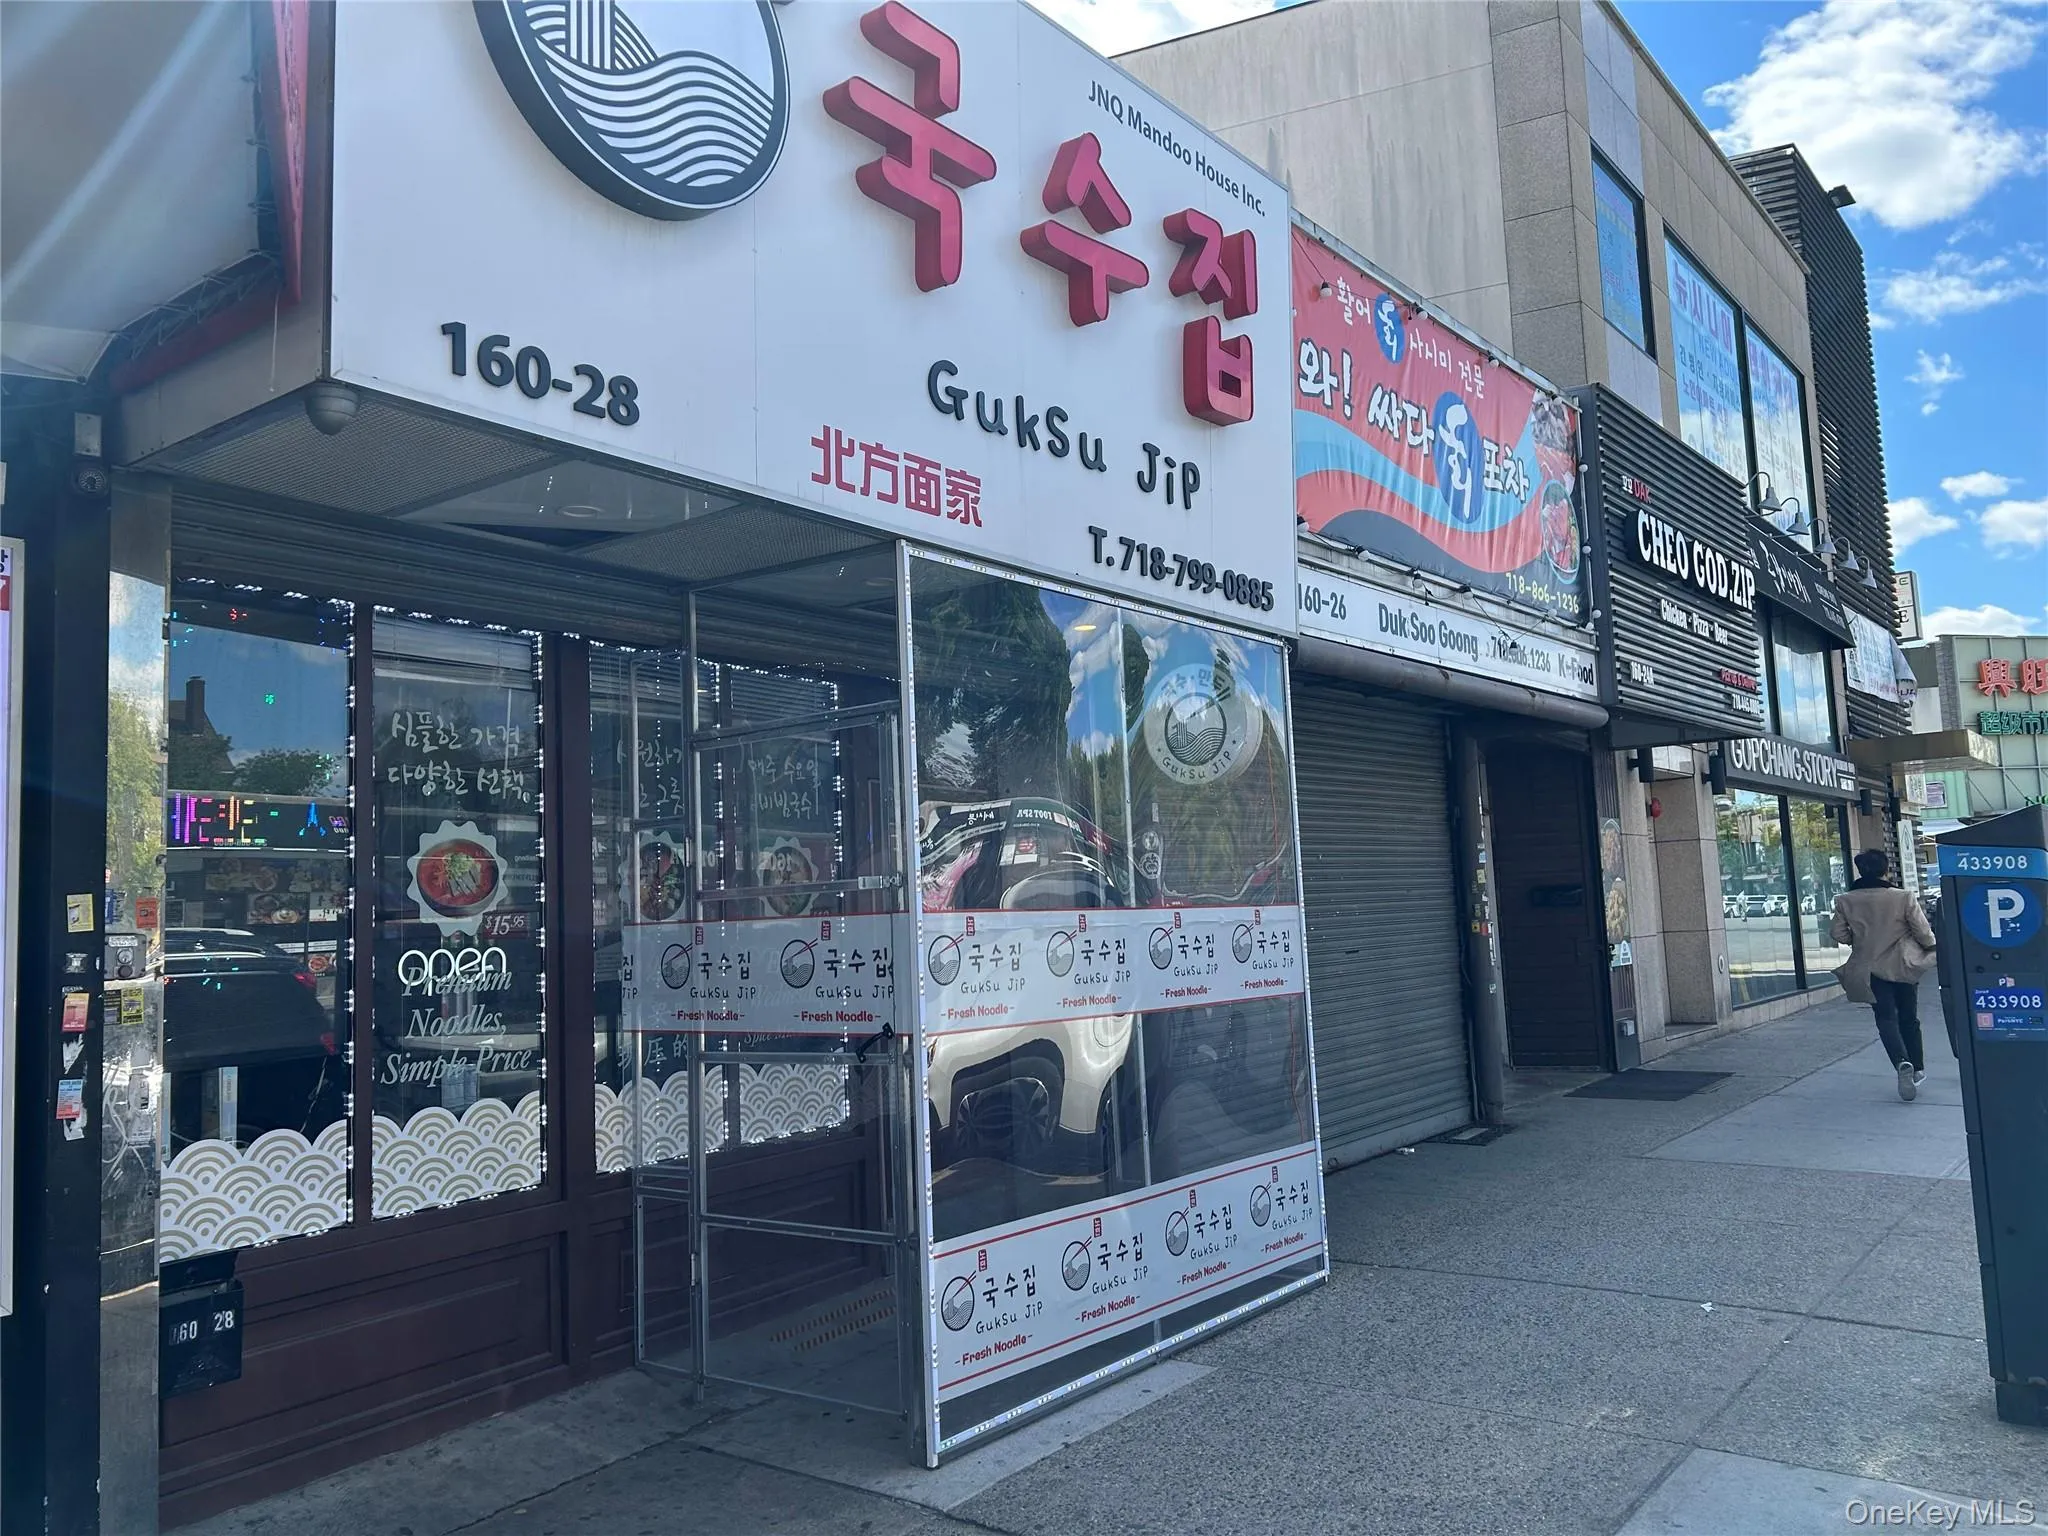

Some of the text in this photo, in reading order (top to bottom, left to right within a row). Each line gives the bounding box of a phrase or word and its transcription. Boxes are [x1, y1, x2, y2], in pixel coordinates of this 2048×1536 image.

[1088, 79, 1266, 217] JNQ Mandoo House Inc.
[822, 1, 1259, 426] 국수집
[1409, 327, 1452, 373] 사시미
[441, 321, 640, 427] 160-28
[927, 359, 1107, 472] GukSu
[811, 424, 983, 528] 北方面家
[1637, 509, 1689, 580] CHEO
[1088, 525, 1274, 611] T.718-799-0885
[1506, 572, 1580, 614] 718-806-1236
[1378, 603, 1479, 662] Duk Soo Goong
[1162, 756, 1205, 779] GukSu
[1958, 855, 2028, 870] 433908
[485, 914, 525, 936] $15.95
[1987, 888, 2025, 938] P
[1081, 938, 1126, 966] 국수집
[1177, 934, 1215, 960] 국수집
[1257, 930, 1290, 952] 국수집
[698, 952, 751, 980] 국수집
[824, 947, 888, 978] 국수집
[969, 942, 1021, 973] 국수집
[1174, 966, 1201, 977] GukSu
[1252, 960, 1278, 970] GukSu
[816, 986, 862, 998] GukSu
[961, 980, 1000, 994] GukSu
[1074, 971, 1108, 985] GukSu
[690, 987, 729, 998] GukSu
[1976, 995, 2042, 1009] 433908
[1275, 1179, 1309, 1211] 국수집
[1193, 1204, 1232, 1239] 국수집
[1272, 1216, 1297, 1230] GukSu
[1097, 1232, 1144, 1272] 국수집
[1190, 1244, 1220, 1260] GukSu
[982, 1265, 1037, 1309] 국수집
[1092, 1276, 1127, 1294] GukSu
[214, 1310, 235, 1332] 28
[976, 1314, 1017, 1334] GukSu
